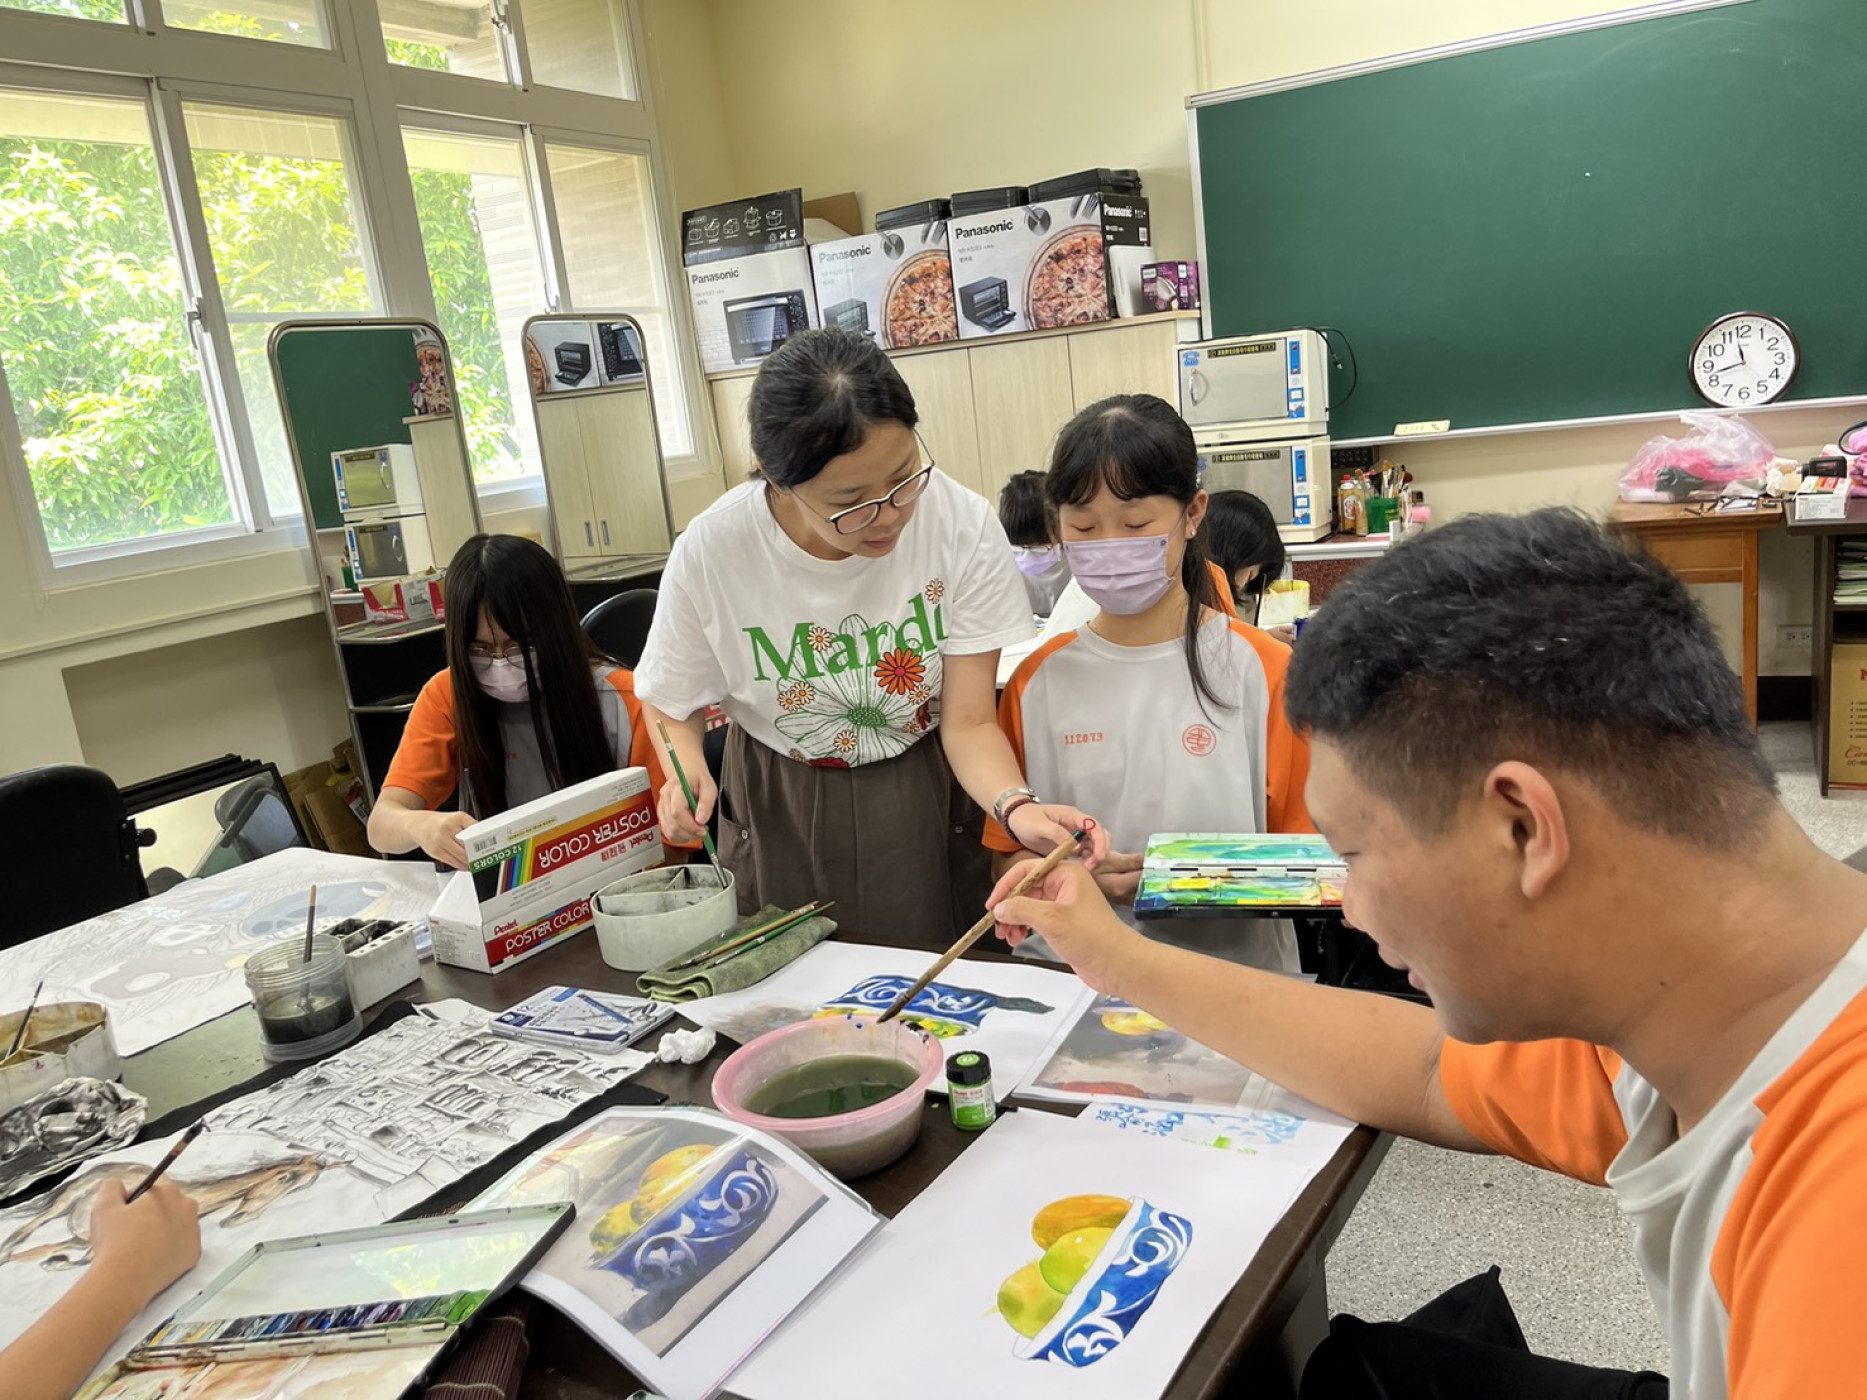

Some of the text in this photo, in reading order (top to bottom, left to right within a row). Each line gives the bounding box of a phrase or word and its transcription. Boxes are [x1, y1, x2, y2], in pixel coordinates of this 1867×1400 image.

[1103, 203, 1132, 218] Panasonic
[955, 219, 1014, 239] Panasonic
[819, 245, 872, 263] Panasonic
[691, 267, 740, 285] Panasonic
[1722, 331, 1733, 344] 11
[1735, 324, 1752, 339] 12
[1759, 327, 1764, 340] 1
[1708, 344, 1725, 357] 10
[1767, 337, 1779, 351] 2
[1774, 352, 1785, 365] 3
[1702, 360, 1714, 373] 9
[1768, 368, 1780, 380] 4
[1708, 374, 1719, 388] 8
[1756, 380, 1768, 393] 5
[1722, 384, 1734, 397] 7
[1738, 387, 1750, 400] 6
[742, 592, 949, 682] Mardi
[592, 806, 651, 844] POSTER
[630, 831, 654, 848] Pentel
[473, 845, 522, 870] 12 COLORS
[538, 834, 590, 868] COLOR
[493, 919, 518, 936] Pentel
[505, 921, 552, 953] POSTER
[553, 902, 590, 928] COLOR
